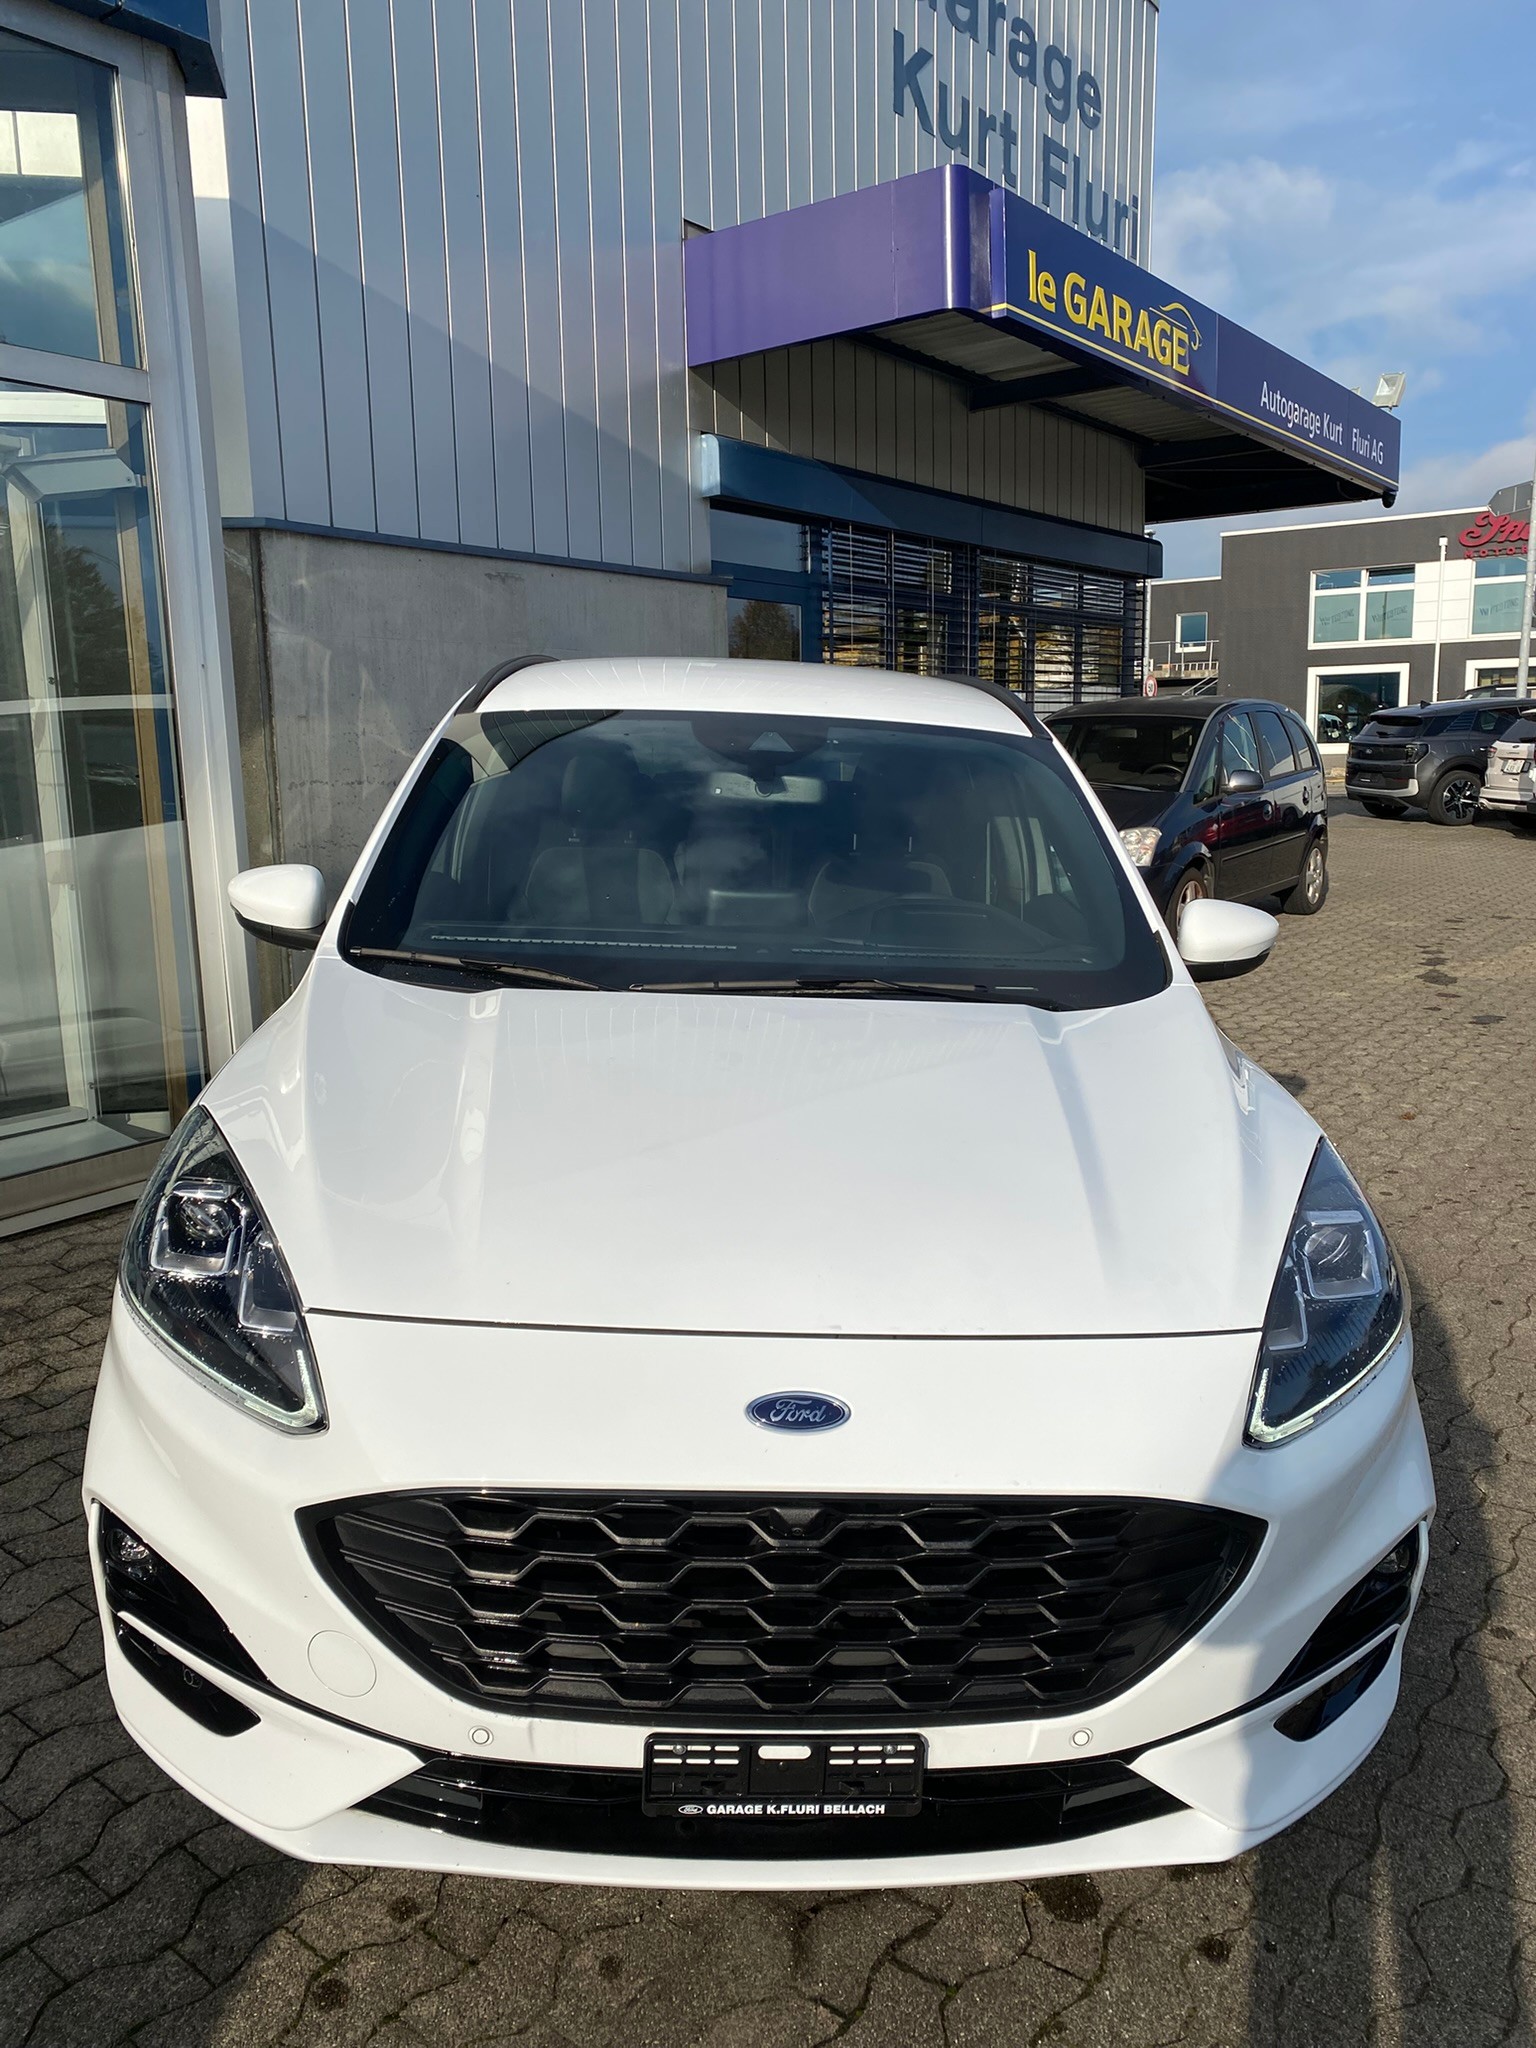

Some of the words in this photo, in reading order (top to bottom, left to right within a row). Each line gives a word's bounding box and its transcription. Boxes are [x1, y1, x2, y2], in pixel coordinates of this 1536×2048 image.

[918, 0, 1101, 130] arage
[893, 27, 1016, 188] Kurt
[1041, 133, 1139, 260] Fluri
[1028, 249, 1056, 313] le
[1064, 272, 1190, 376] GARAGE
[1260, 381, 1321, 438] Autogarage
[1323, 412, 1343, 446] Kurt
[1352, 427, 1370, 458] Fluri
[1371, 438, 1384, 465] AG
[769, 1399, 827, 1422] Ford
[706, 1804, 763, 1815] GARAGE
[766, 1804, 820, 1815] K.FLURI
[823, 1804, 885, 1815] BELLACH
